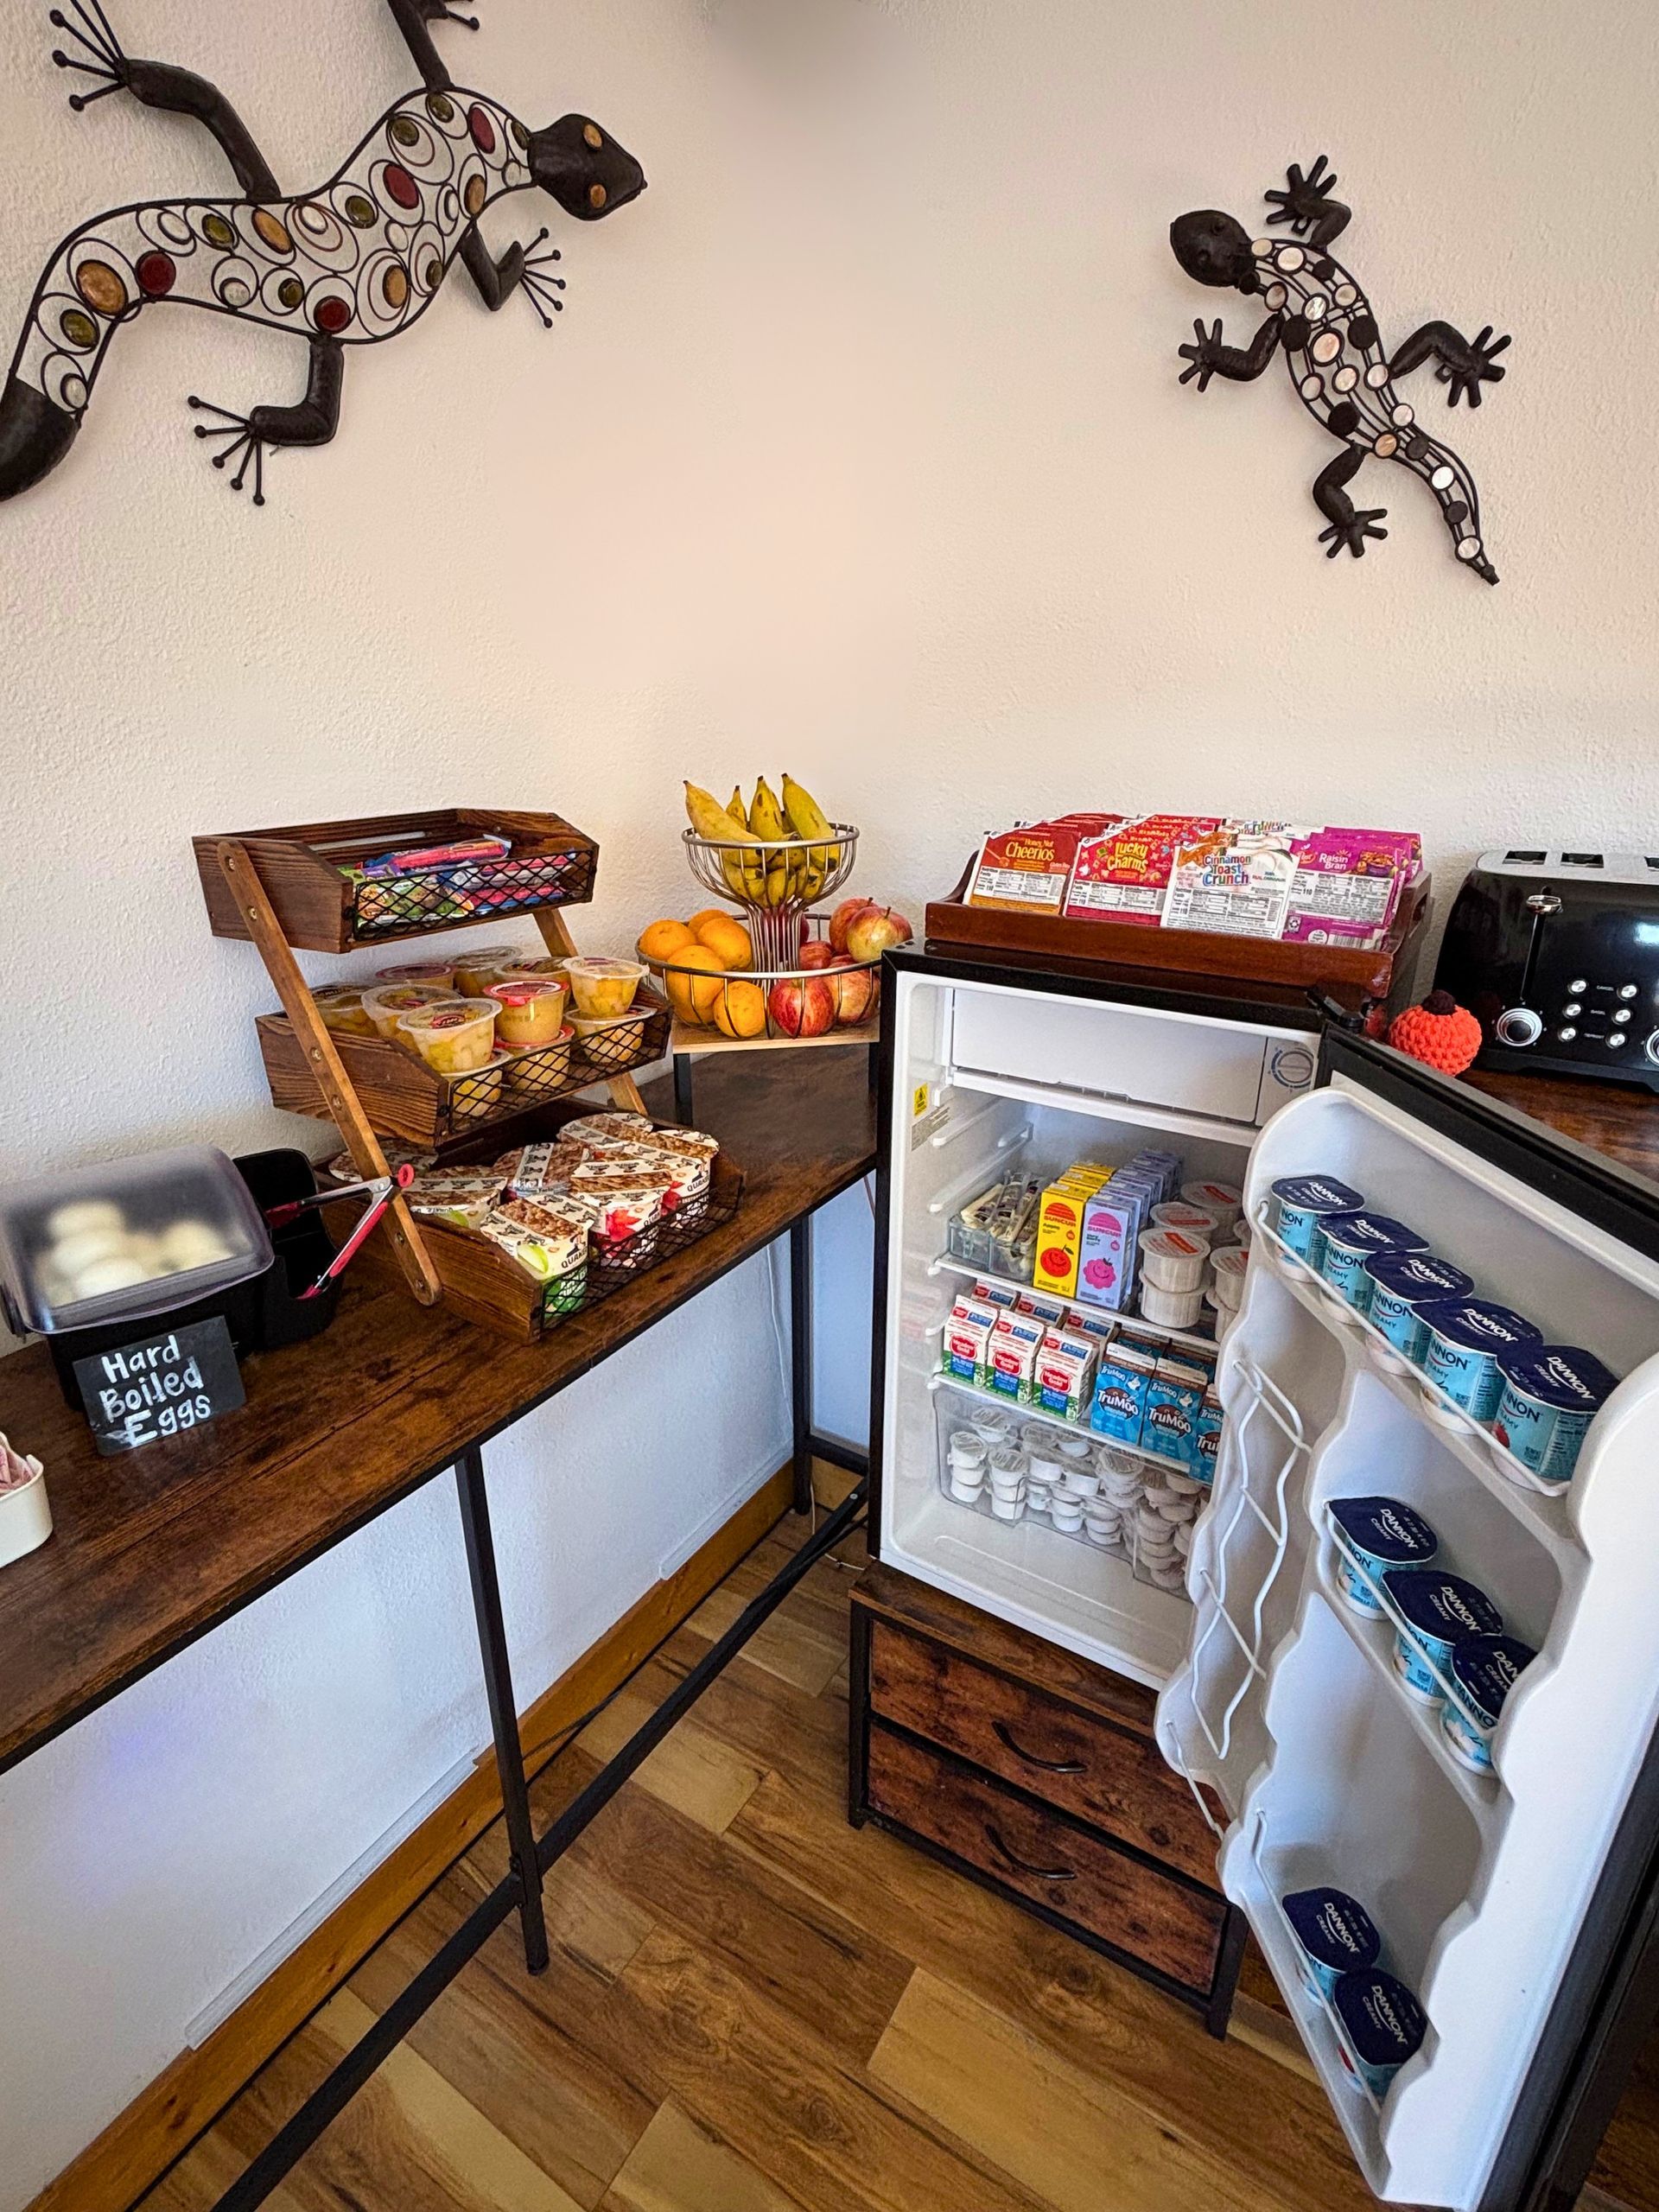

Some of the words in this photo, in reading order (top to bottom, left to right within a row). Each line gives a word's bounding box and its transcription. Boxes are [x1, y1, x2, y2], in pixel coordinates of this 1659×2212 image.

[1006, 842, 1055, 861] Cheerios
[1115, 842, 1149, 860] Lucky
[1204, 855, 1251, 865] Cinnamon
[1319, 852, 1349, 863] Raisin
[1107, 855, 1149, 874] Charms
[1210, 863, 1243, 874] Toast
[1325, 861, 1347, 871] Bran
[1203, 872, 1250, 887] Crunch
[1307, 1180, 1348, 1206] DANNON
[1354, 1218, 1395, 1244] DANNON
[1407, 1259, 1456, 1289] DANNON
[1461, 1307, 1519, 1342] DANNON
[101, 1334, 181, 1383] Hard
[1101, 1365, 1126, 1382] TruMoo
[1545, 1356, 1596, 1401] DANNON
[99, 1356, 204, 1423] Boiled
[1097, 1389, 1139, 1416] TruMoo
[1151, 1382, 1178, 1399] TruMoo
[124, 1395, 211, 1447] Eggs
[1148, 1407, 1192, 1433] TruMoo
[1380, 1508, 1419, 1549] DANNON
[1440, 1586, 1482, 1632] DANNON
[1324, 1901, 1360, 1953] DANNON
[1371, 1985, 1408, 2045] DANNON
